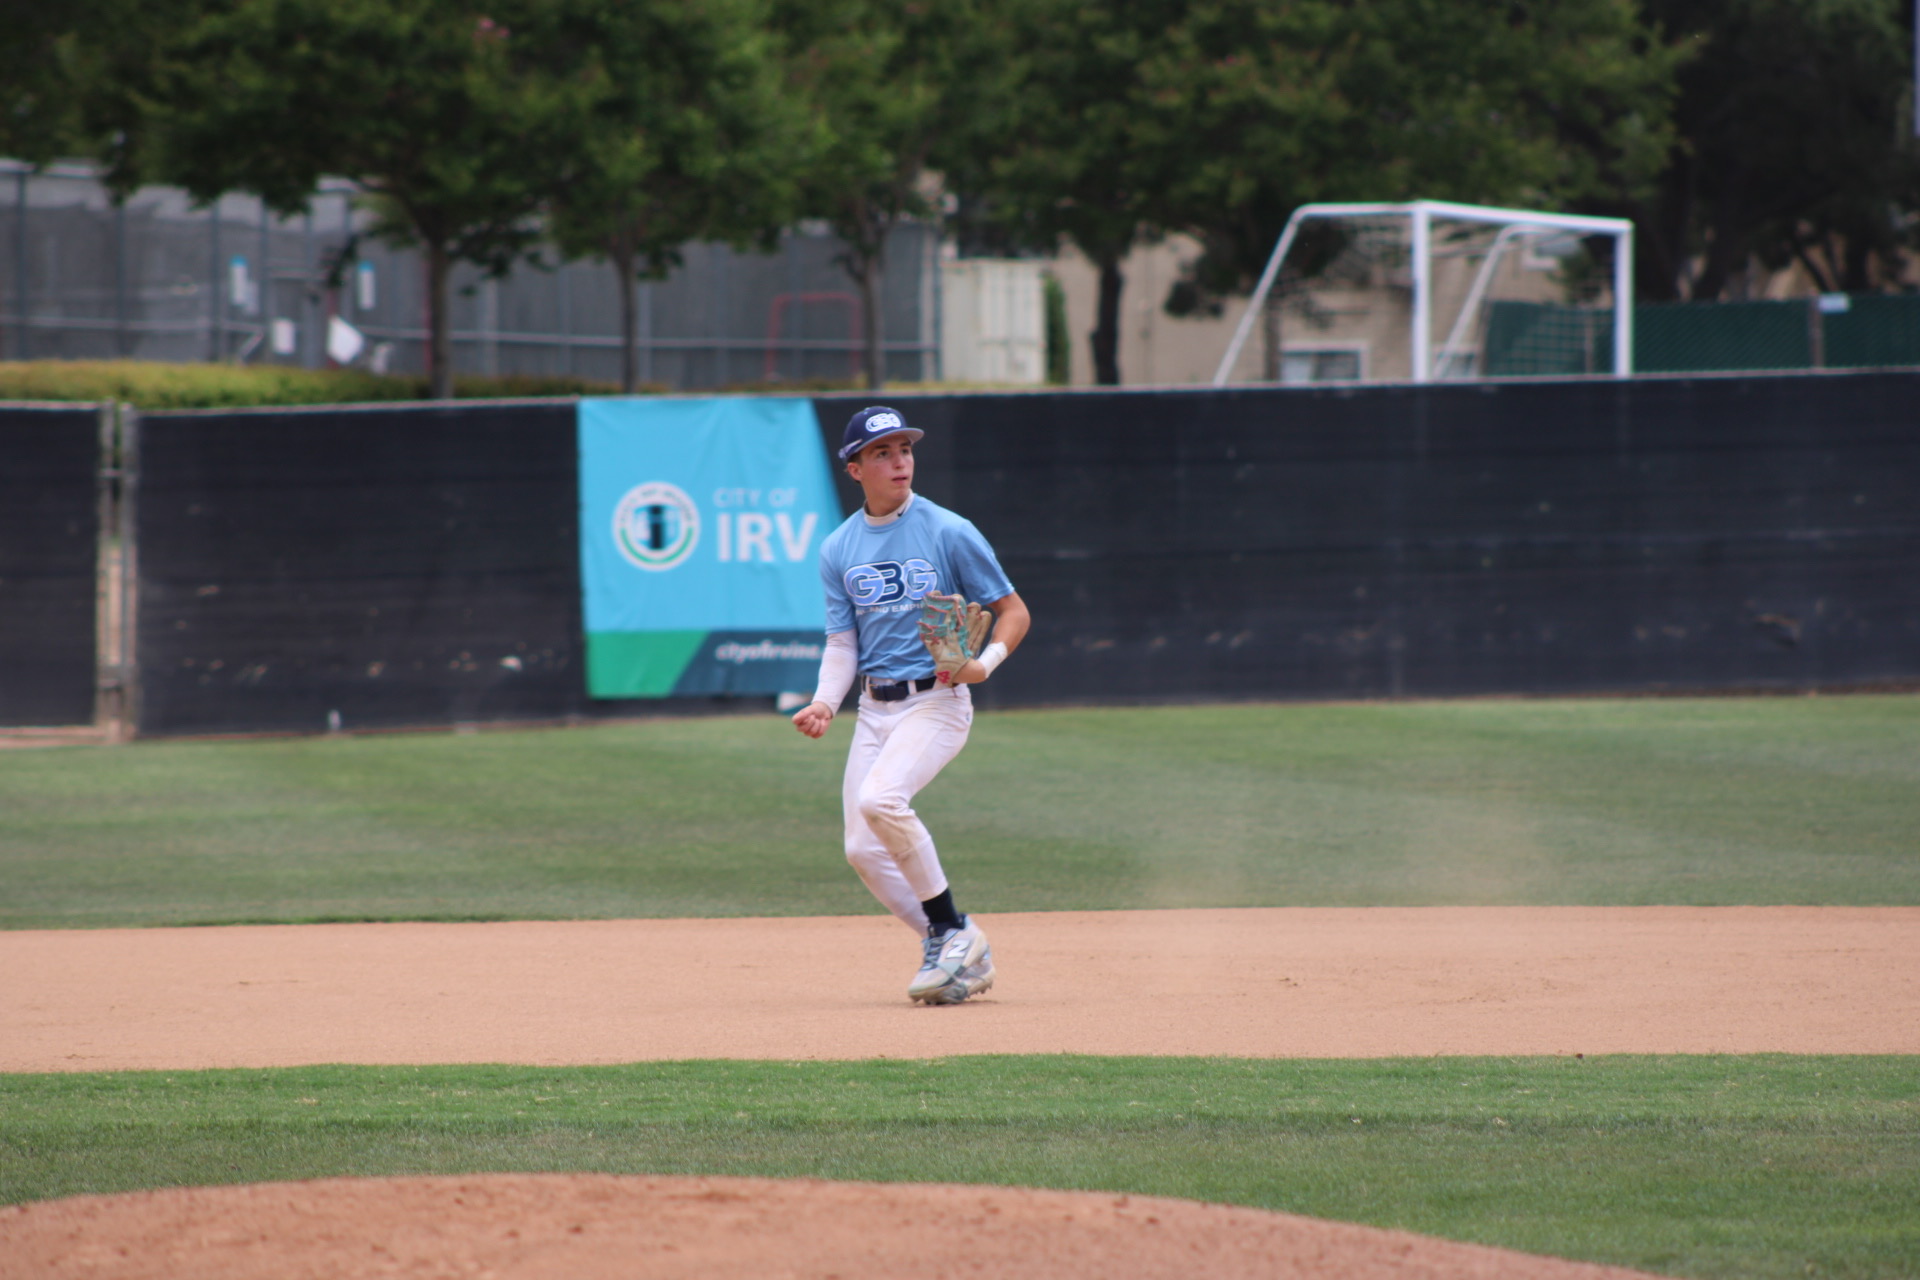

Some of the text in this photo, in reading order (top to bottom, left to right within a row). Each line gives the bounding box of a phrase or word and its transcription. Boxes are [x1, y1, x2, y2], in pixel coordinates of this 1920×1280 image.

[713, 487, 761, 507] CITY
[768, 487, 799, 507] OF
[717, 512, 819, 562] IRV
[843, 558, 938, 607] GBG
